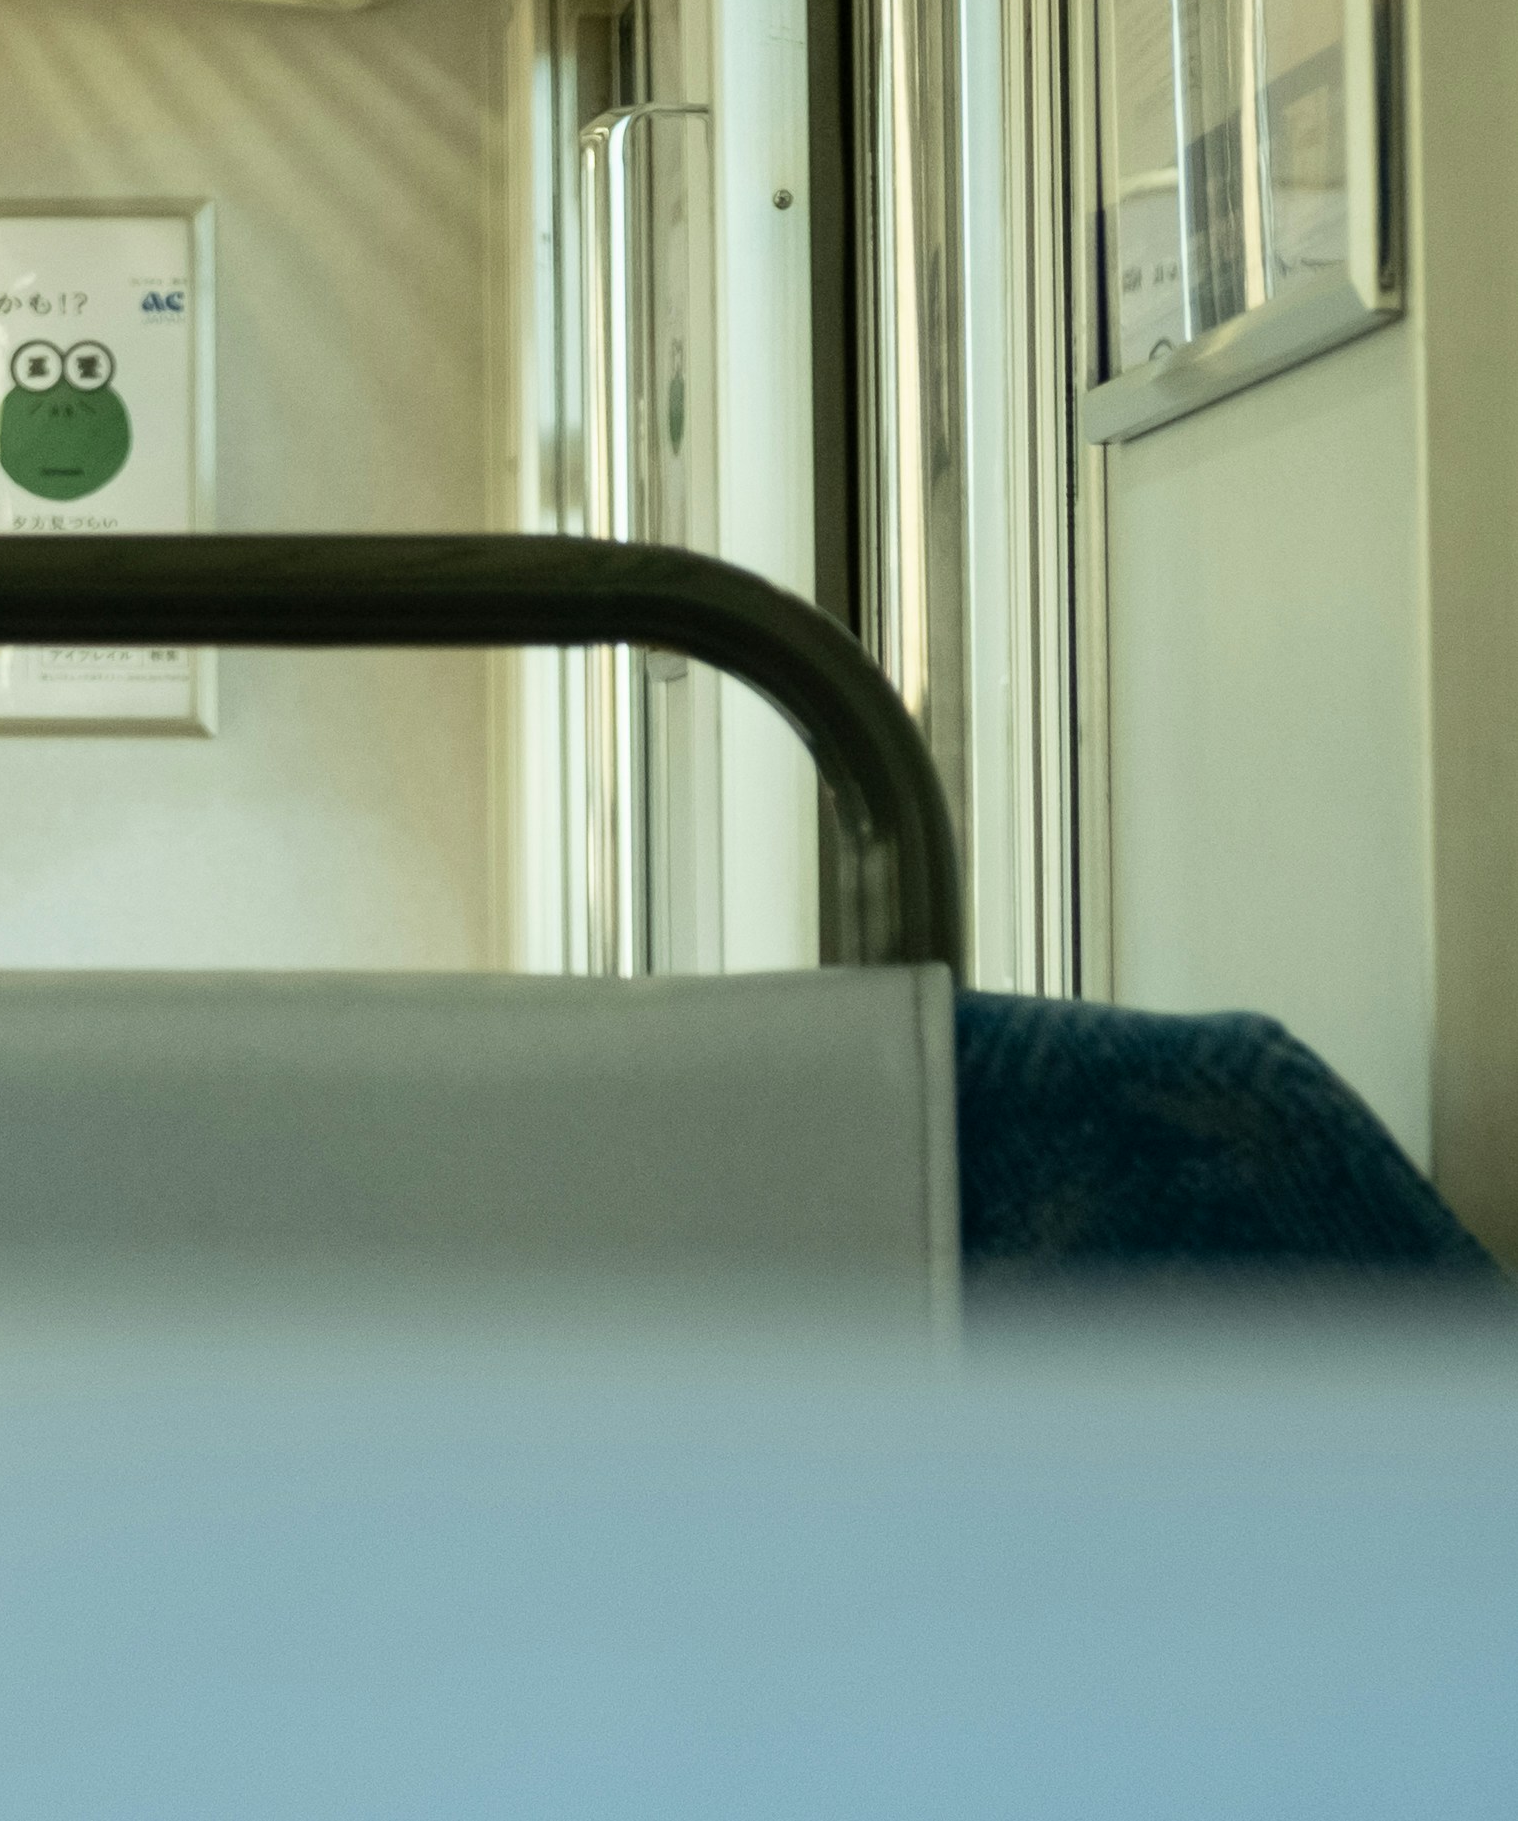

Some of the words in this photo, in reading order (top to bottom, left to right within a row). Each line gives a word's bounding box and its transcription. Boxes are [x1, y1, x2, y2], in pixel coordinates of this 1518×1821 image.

[141, 290, 185, 312] AC
[12, 514, 119, 531] 夕方見づらい
